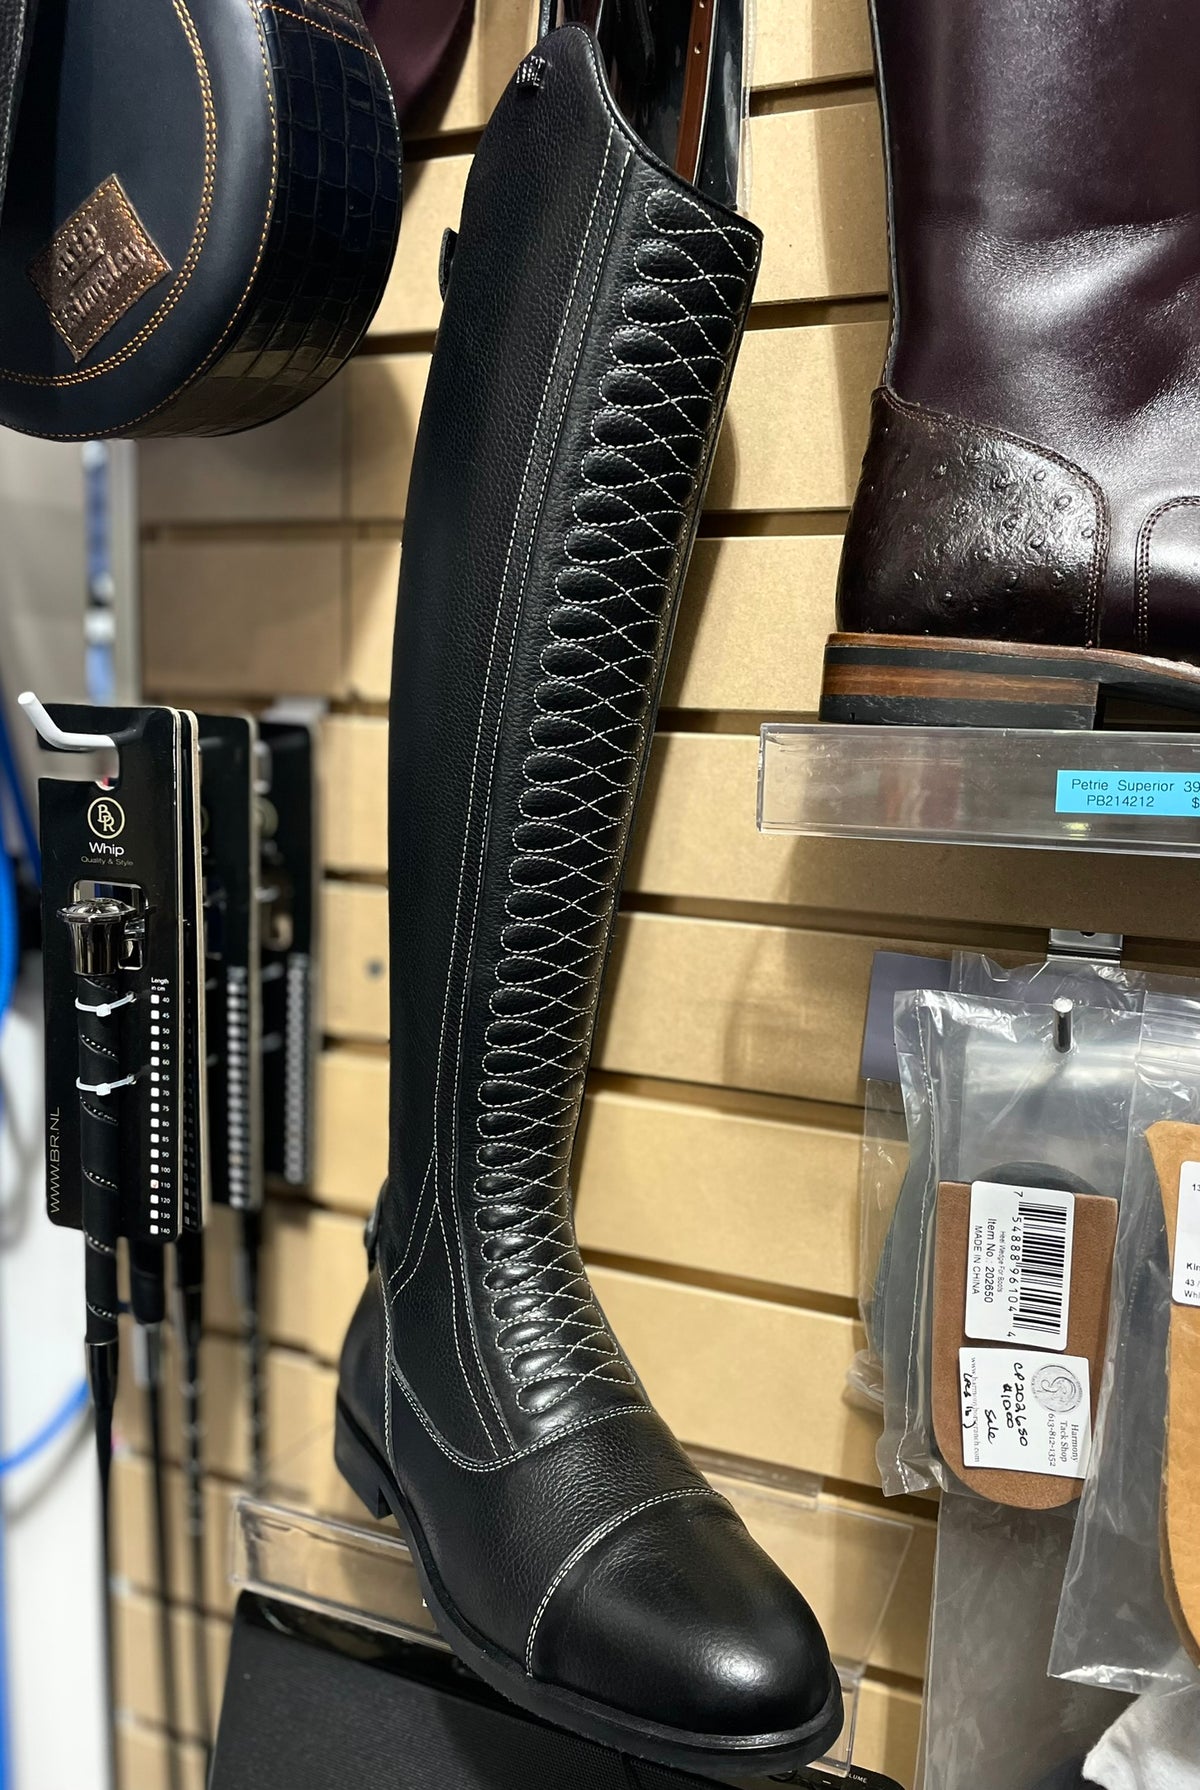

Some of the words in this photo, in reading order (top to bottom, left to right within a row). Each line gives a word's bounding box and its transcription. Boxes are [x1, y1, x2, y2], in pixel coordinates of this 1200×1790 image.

[1071, 778, 1108, 791] Petrie
[1117, 779, 1174, 793] Superior
[1086, 794, 1155, 807] PB214212
[89, 842, 125, 857] Whip
[81, 856, 105, 865] Quality
[107, 858, 114, 866] &
[115, 858, 134, 867] Style
[162, 1089, 170, 1097] 70
[50, 1106, 60, 1213] WWW.BR.NL
[973, 1225, 982, 1251] MADE
[986, 1218, 997, 1240] Item
[1010, 1216, 1022, 1262] 54888
[973, 1254, 981, 1264] IN
[972, 1266, 981, 1295] CHINA
[984, 1266, 995, 1303] 202650
[1008, 1268, 1020, 1312] 96104
[1047, 1413, 1057, 1467] 613-812-1352
[1060, 1421, 1068, 1439] Tack
[1060, 1441, 1069, 1462] Shop
[1070, 1424, 1079, 1462] Harmony
